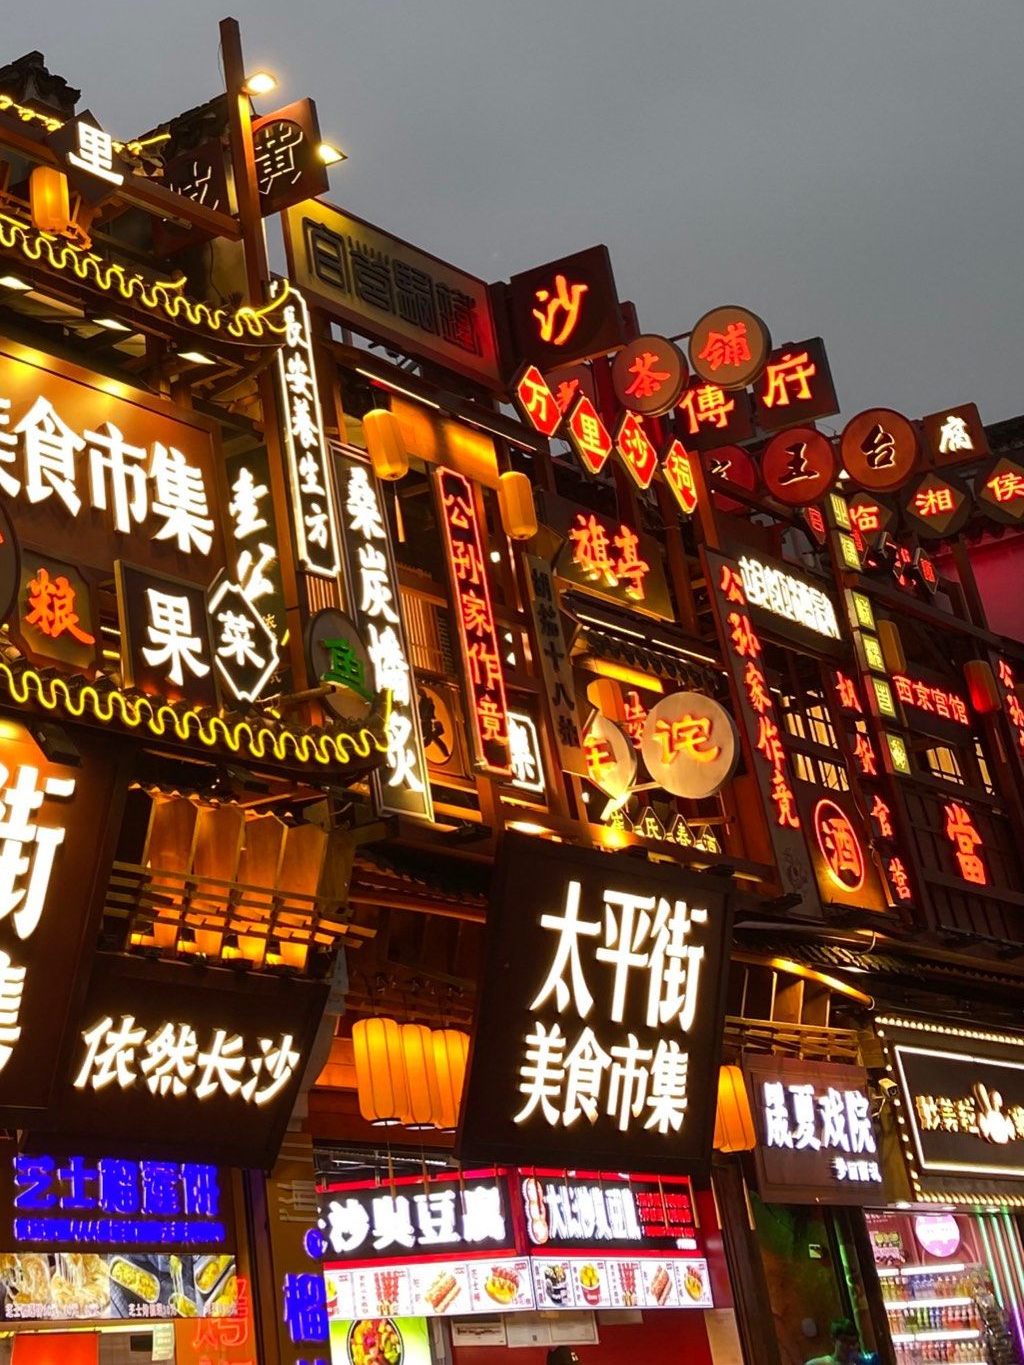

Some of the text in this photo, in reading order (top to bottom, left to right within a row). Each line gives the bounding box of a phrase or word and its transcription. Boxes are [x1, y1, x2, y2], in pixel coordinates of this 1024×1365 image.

[533, 275, 588, 345] 沙
[570, 513, 652, 601] 旗亭
[141, 587, 211, 687] 果
[216, 609, 266, 671] 菜
[821, 818, 861, 878] 酒
[528, 880, 709, 1033] 太平街
[74, 1015, 302, 1106] 依然长沙
[513, 1021, 689, 1135] 美食市集
